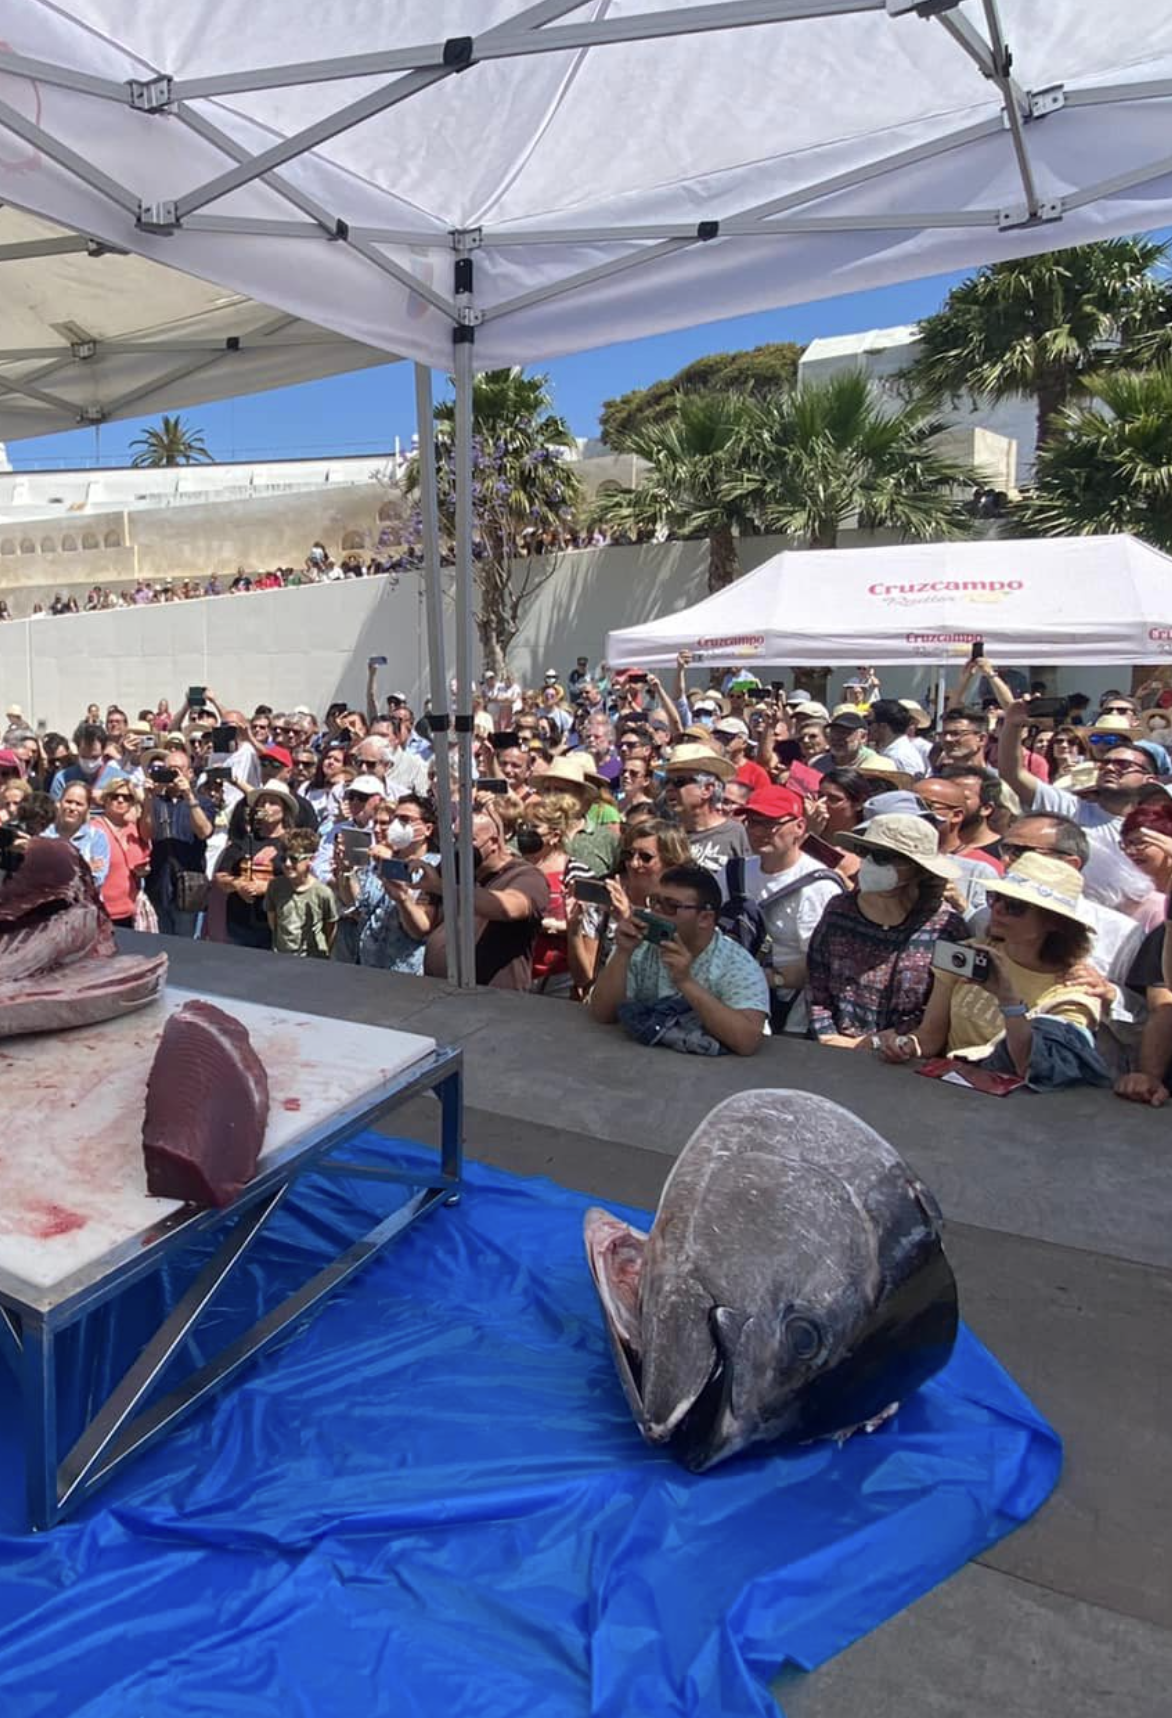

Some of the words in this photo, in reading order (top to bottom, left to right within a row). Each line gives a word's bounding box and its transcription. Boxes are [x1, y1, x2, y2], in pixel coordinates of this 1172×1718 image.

[868, 580, 1024, 596] Cruzcampo
[698, 635, 765, 648] Cruzcampo
[906, 632, 984, 643] Cruzcampo
